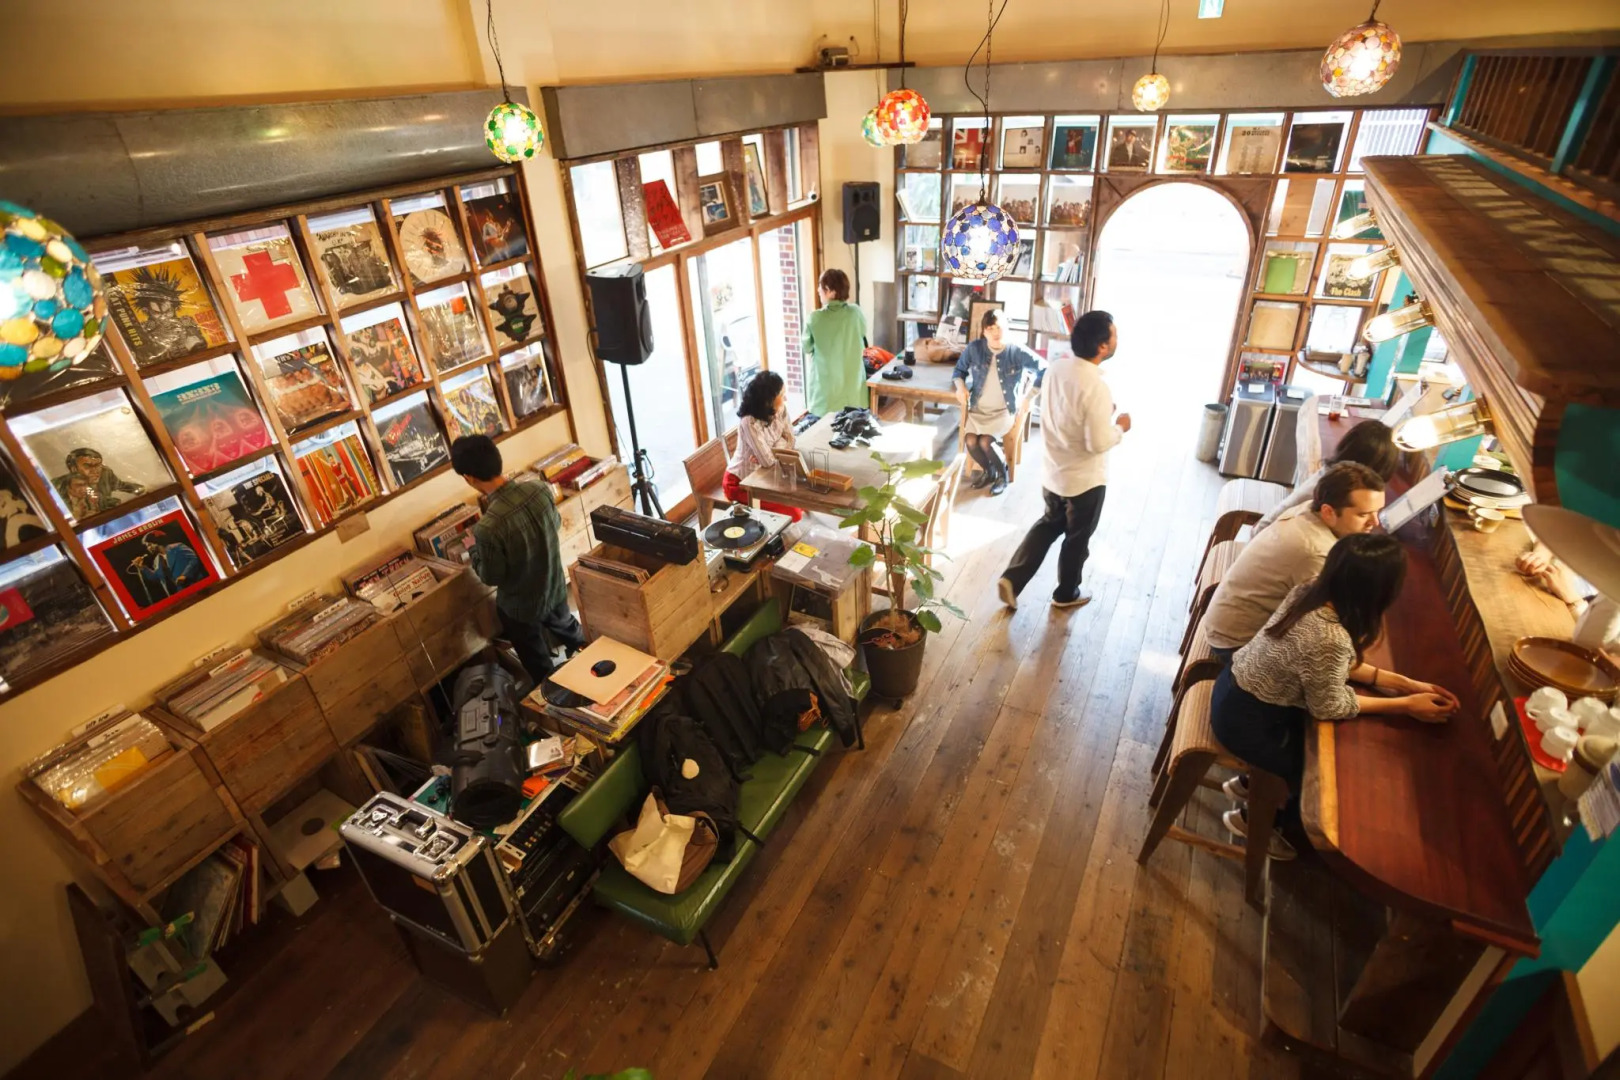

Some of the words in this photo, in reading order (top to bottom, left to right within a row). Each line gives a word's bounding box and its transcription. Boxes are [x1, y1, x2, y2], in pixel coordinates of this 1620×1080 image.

[1330, 287, 1343, 296] The
[1344, 287, 1362, 297] Clash
[117, 308, 133, 329] PUNK
[126, 327, 143, 347] HITS
[243, 480, 254, 491] THE
[253, 472, 275, 486] SPECIALS
[113, 530, 138, 544] JAMES
[139, 519, 164, 533] BROWN
